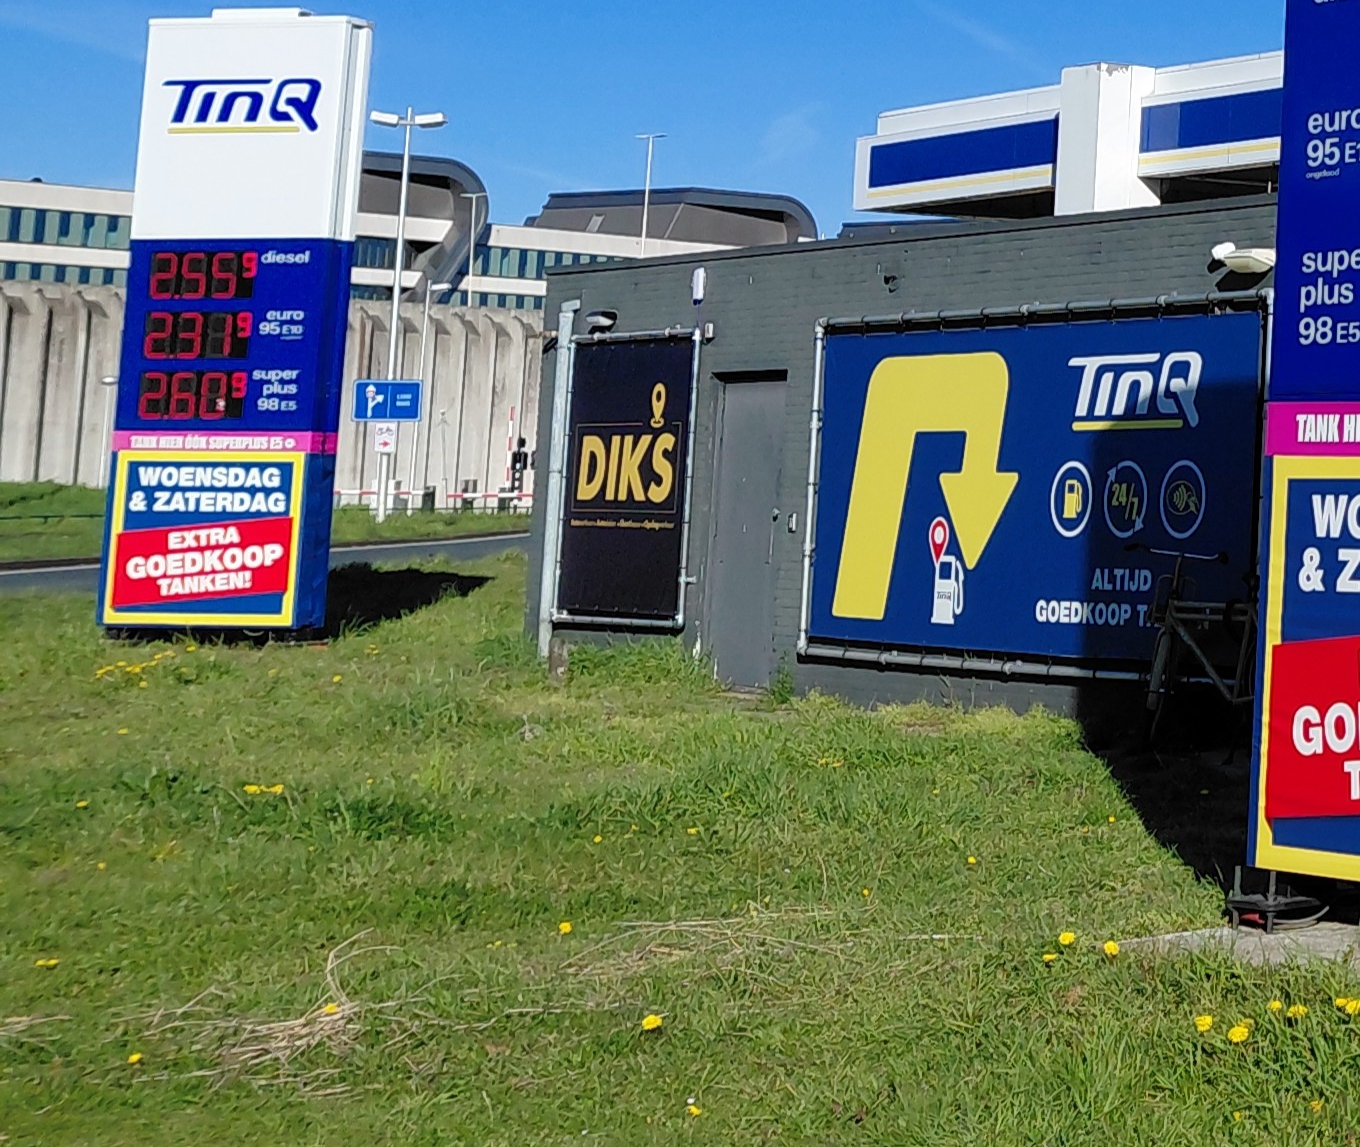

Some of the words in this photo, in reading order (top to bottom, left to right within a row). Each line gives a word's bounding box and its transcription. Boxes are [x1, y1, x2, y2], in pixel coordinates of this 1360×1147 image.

[162, 78, 322, 132] TinQ
[1306, 138, 1341, 168] 95
[261, 251, 311, 264] diesel
[1299, 276, 1354, 316] plus
[258, 322, 280, 335] 95
[281, 324, 303, 335] E10
[266, 310, 304, 322] euro
[1298, 316, 1333, 345] 98
[1336, 322, 1360, 343] E5
[252, 369, 301, 385] super
[262, 381, 298, 396] plus
[1068, 351, 1202, 428] TinQ
[257, 398, 279, 411] 98
[280, 401, 298, 411] E5
[1296, 414, 1341, 444] TANK
[137, 466, 282, 488] WOENSDAG
[577, 432, 676, 503] DIKS
[129, 491, 147, 512] &
[152, 492, 286, 513] ZATERDAG
[1111, 482, 1139, 521] 24/7
[168, 526, 241, 550] EXTRA
[126, 543, 284, 580] GOEDKOOP
[1298, 546, 1325, 593] &
[156, 570, 253, 597] TANKEN!
[1091, 568, 1153, 593] ALTIJD
[1035, 599, 1133, 628] GOEDKOOP
